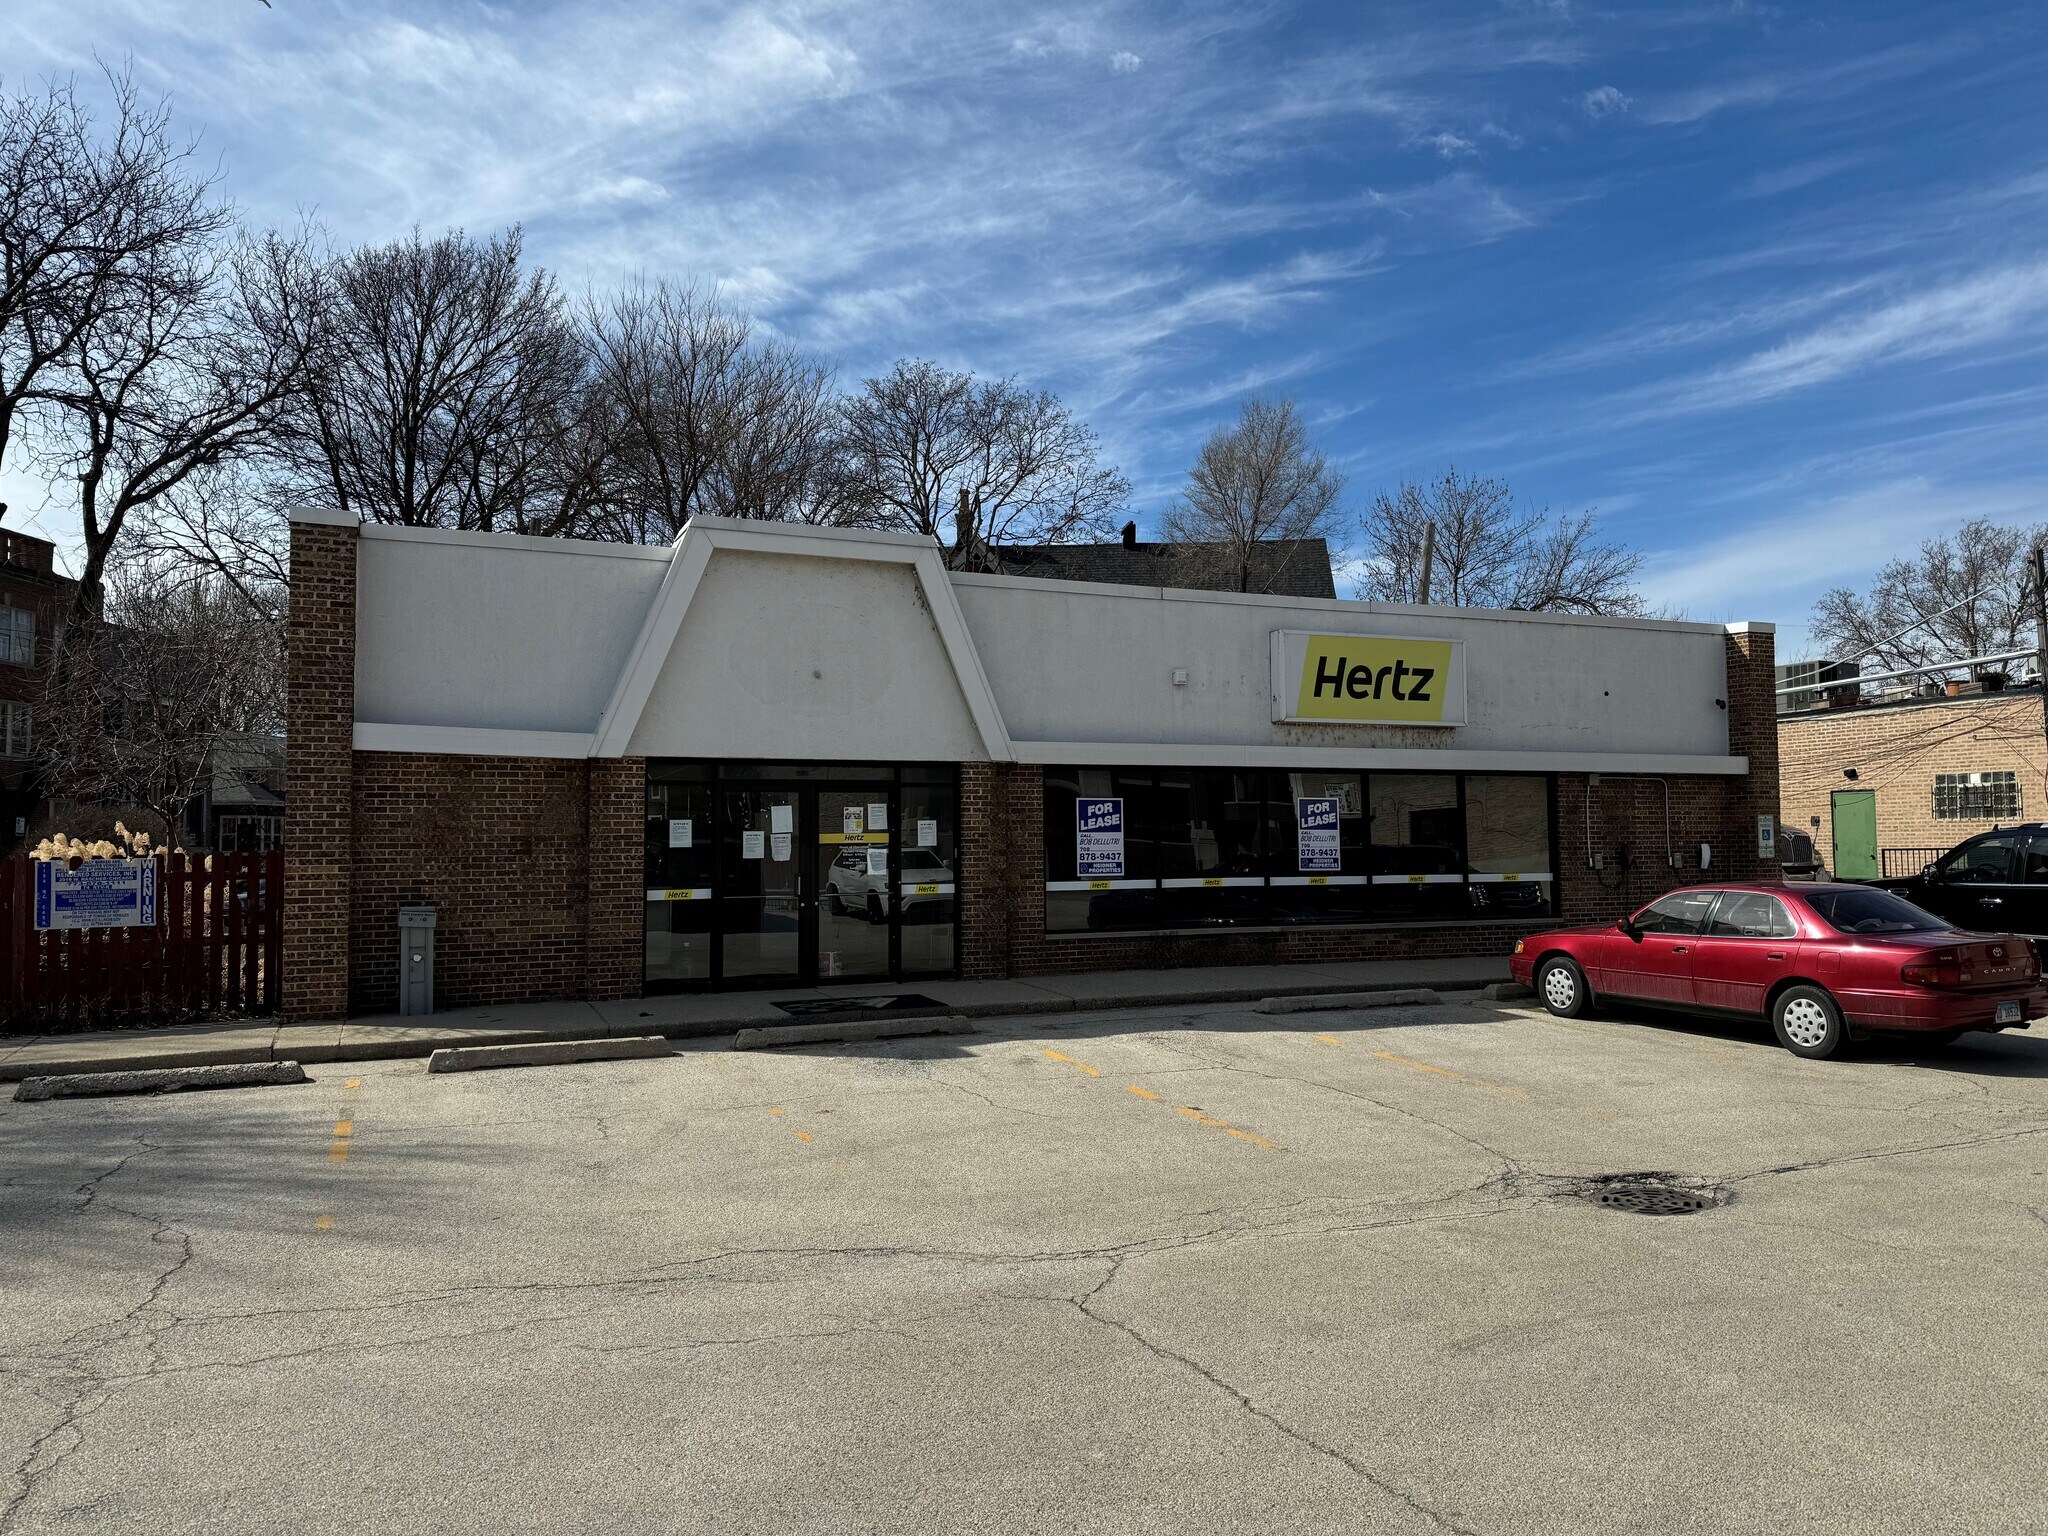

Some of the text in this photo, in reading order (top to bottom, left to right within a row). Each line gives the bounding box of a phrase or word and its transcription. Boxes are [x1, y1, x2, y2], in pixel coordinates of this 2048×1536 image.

[1313, 656, 1435, 702] Hertz
[1087, 802, 1113, 817] FOR
[1307, 801, 1330, 815] FOR
[1080, 813, 1120, 831] LEASE
[1301, 812, 1336, 828] LEASE
[1079, 838, 1092, 846] BOB
[1300, 835, 1312, 843] BOB
[1079, 853, 1121, 861] 878-9437
[1300, 849, 1338, 857] 878-9437
[142, 859, 154, 923] WARNING
[1983, 966, 2018, 974] CAMRY
